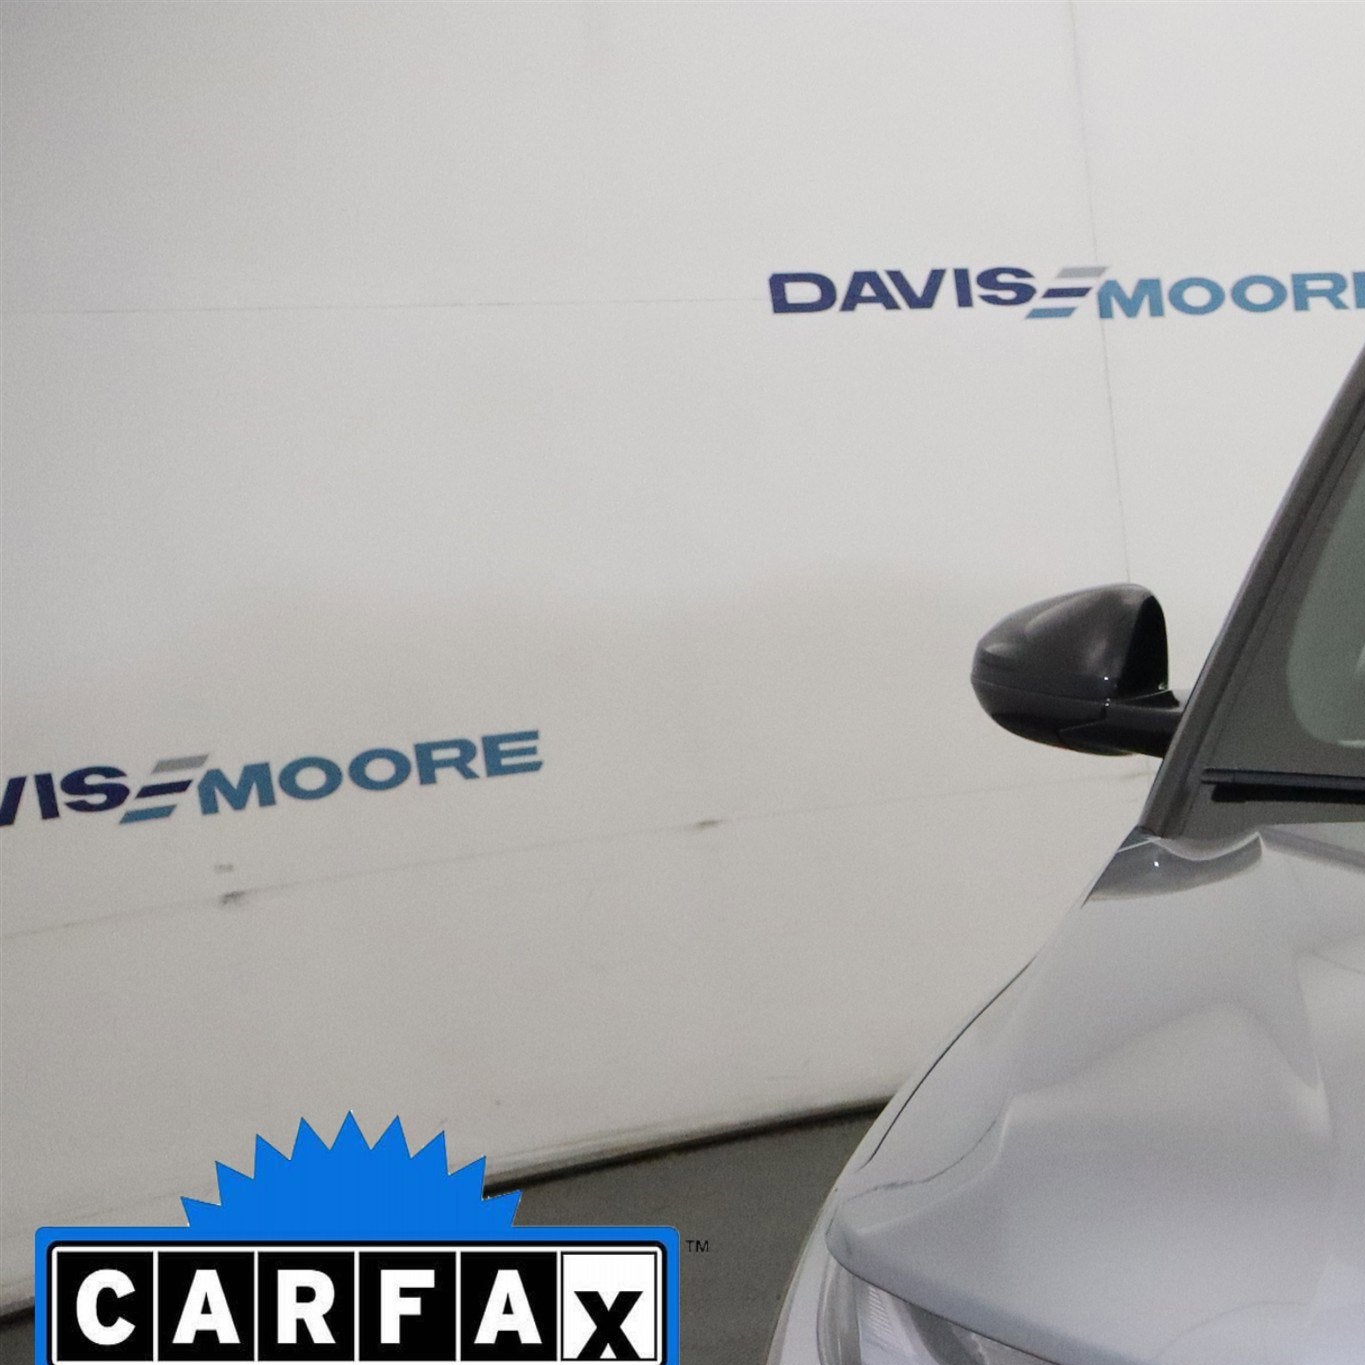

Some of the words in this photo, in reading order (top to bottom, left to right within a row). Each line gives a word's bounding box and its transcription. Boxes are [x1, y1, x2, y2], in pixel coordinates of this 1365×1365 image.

[767, 266, 1036, 314] DAVIS
[0, 765, 130, 827] VIS
[196, 729, 544, 816] MOORE
